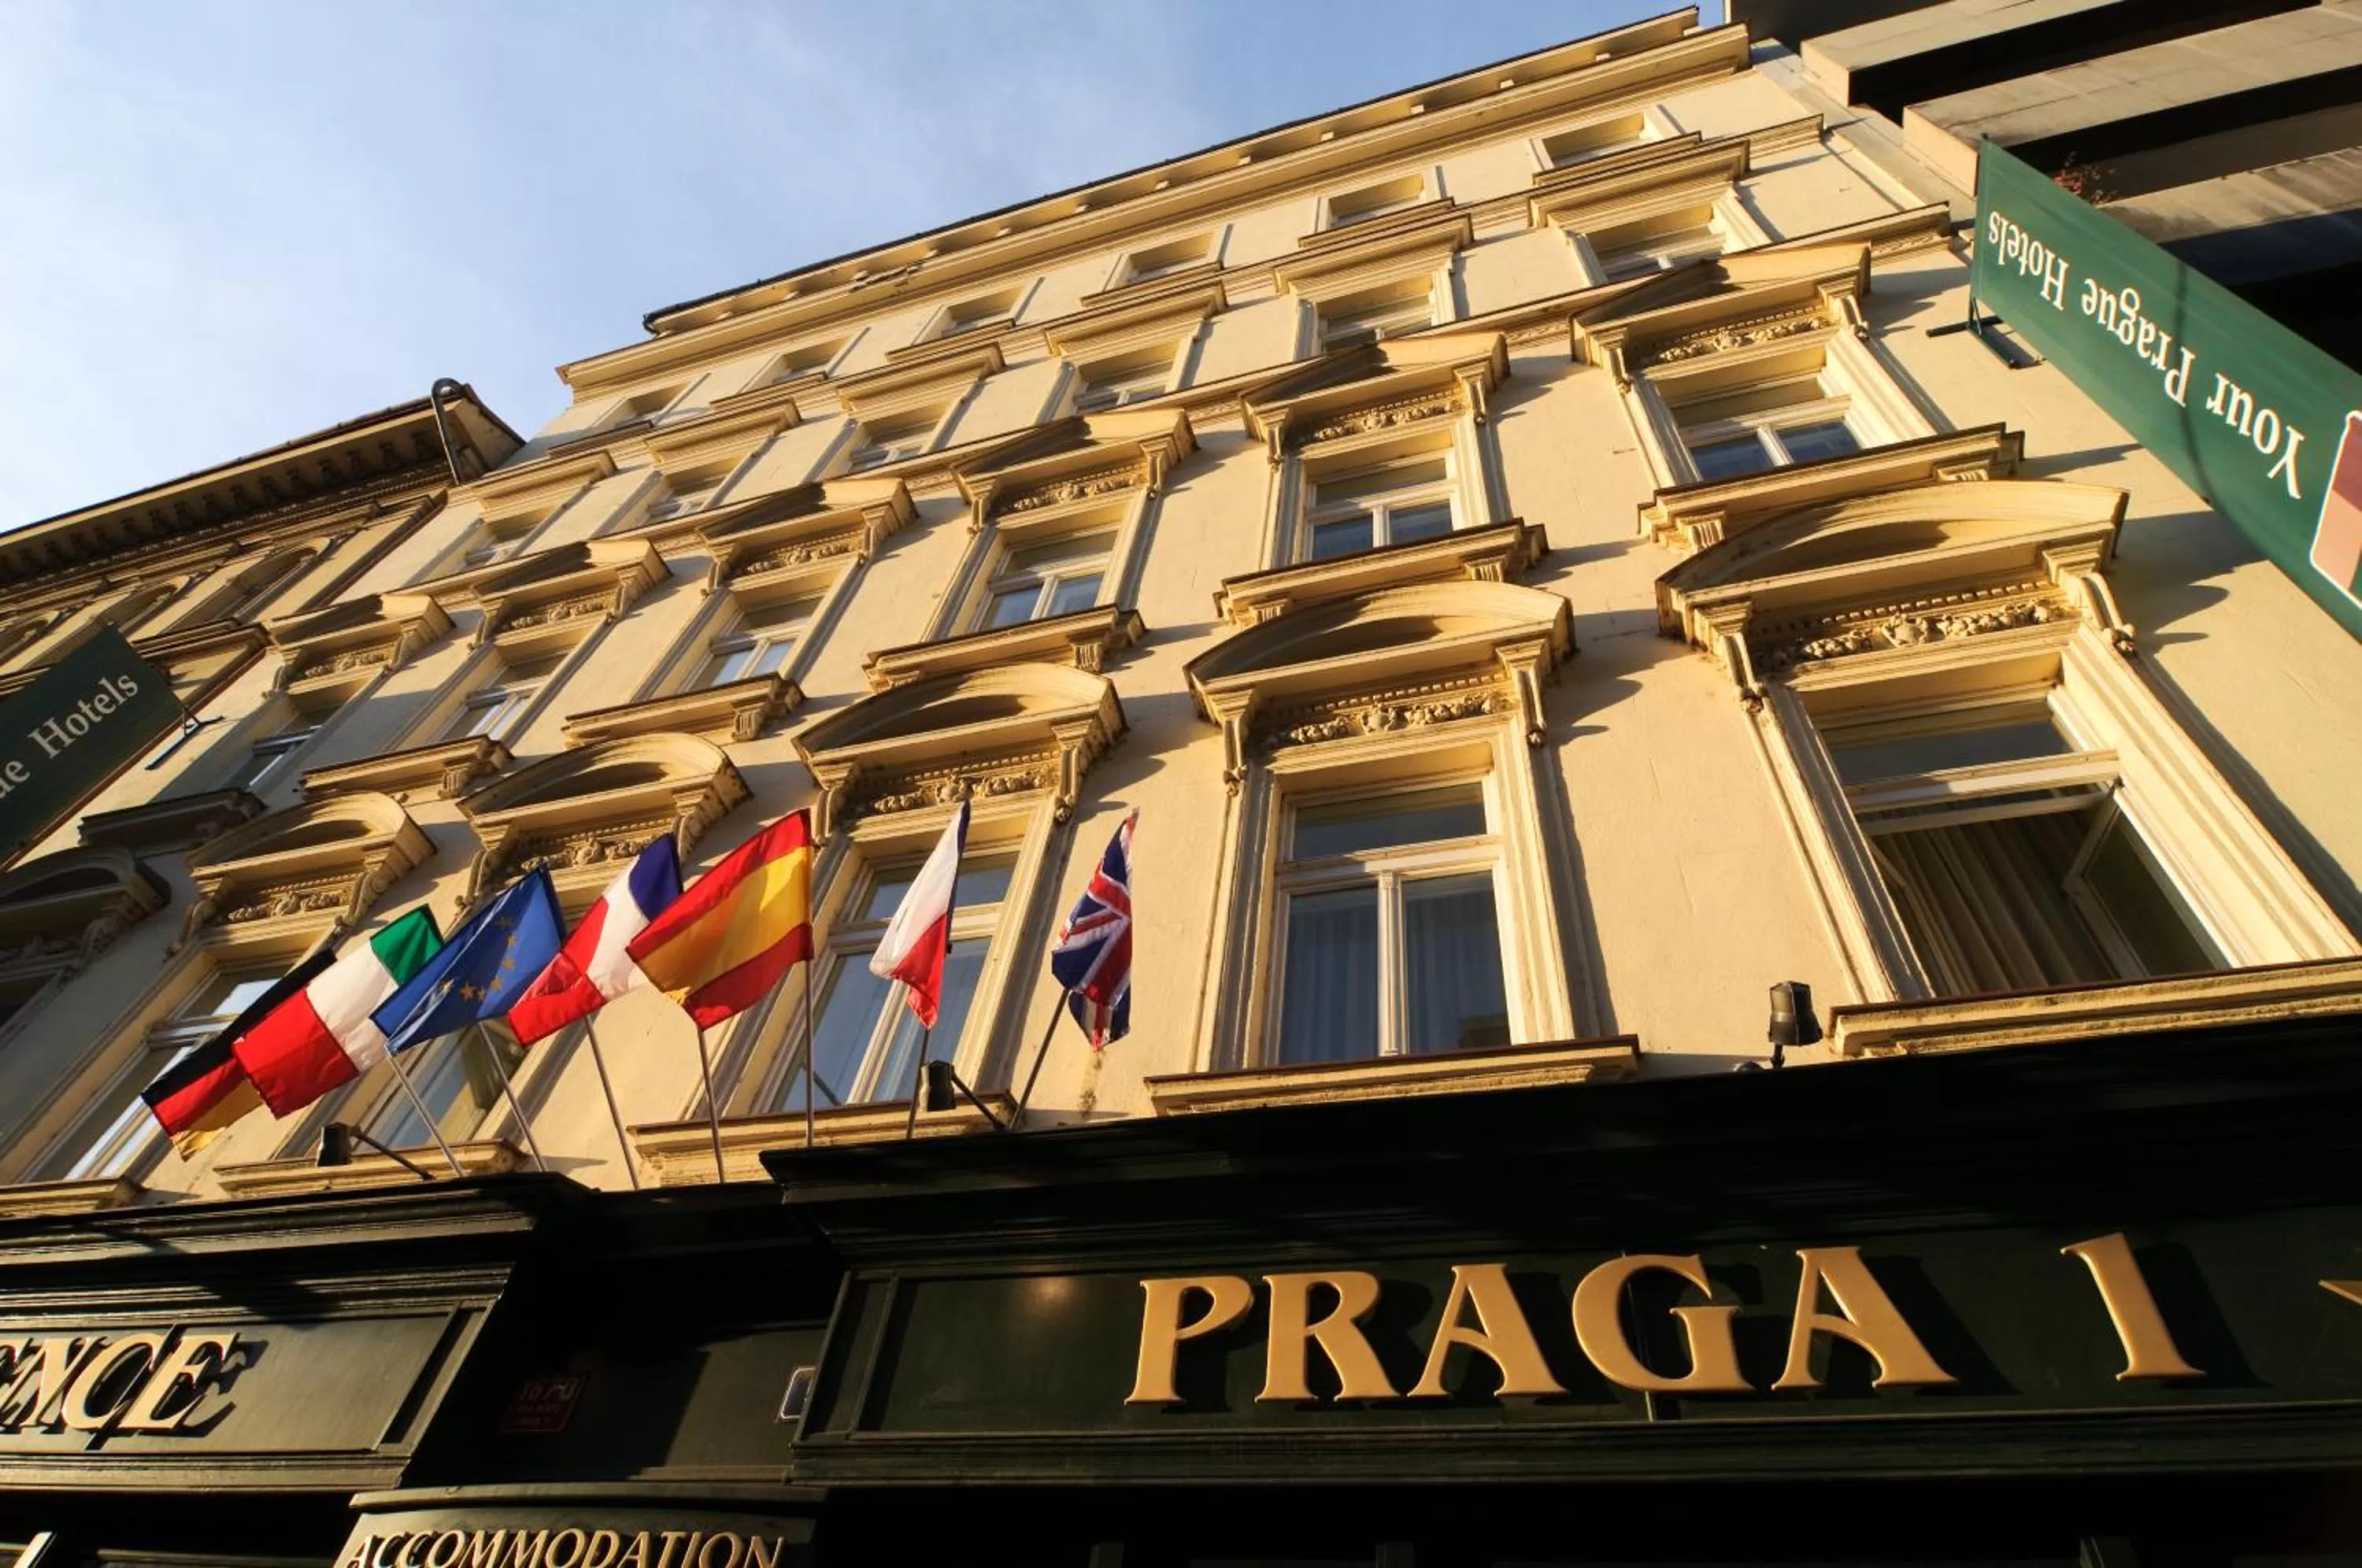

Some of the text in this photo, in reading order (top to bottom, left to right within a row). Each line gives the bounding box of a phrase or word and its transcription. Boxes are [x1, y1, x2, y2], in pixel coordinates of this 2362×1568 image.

[1988, 210, 2305, 500] Your Prague Hotels
[27, 672, 139, 760] Hotels
[1124, 1232, 2208, 1406] PRAGA 1
[343, 1527, 785, 1568] ACCOMMODATION
